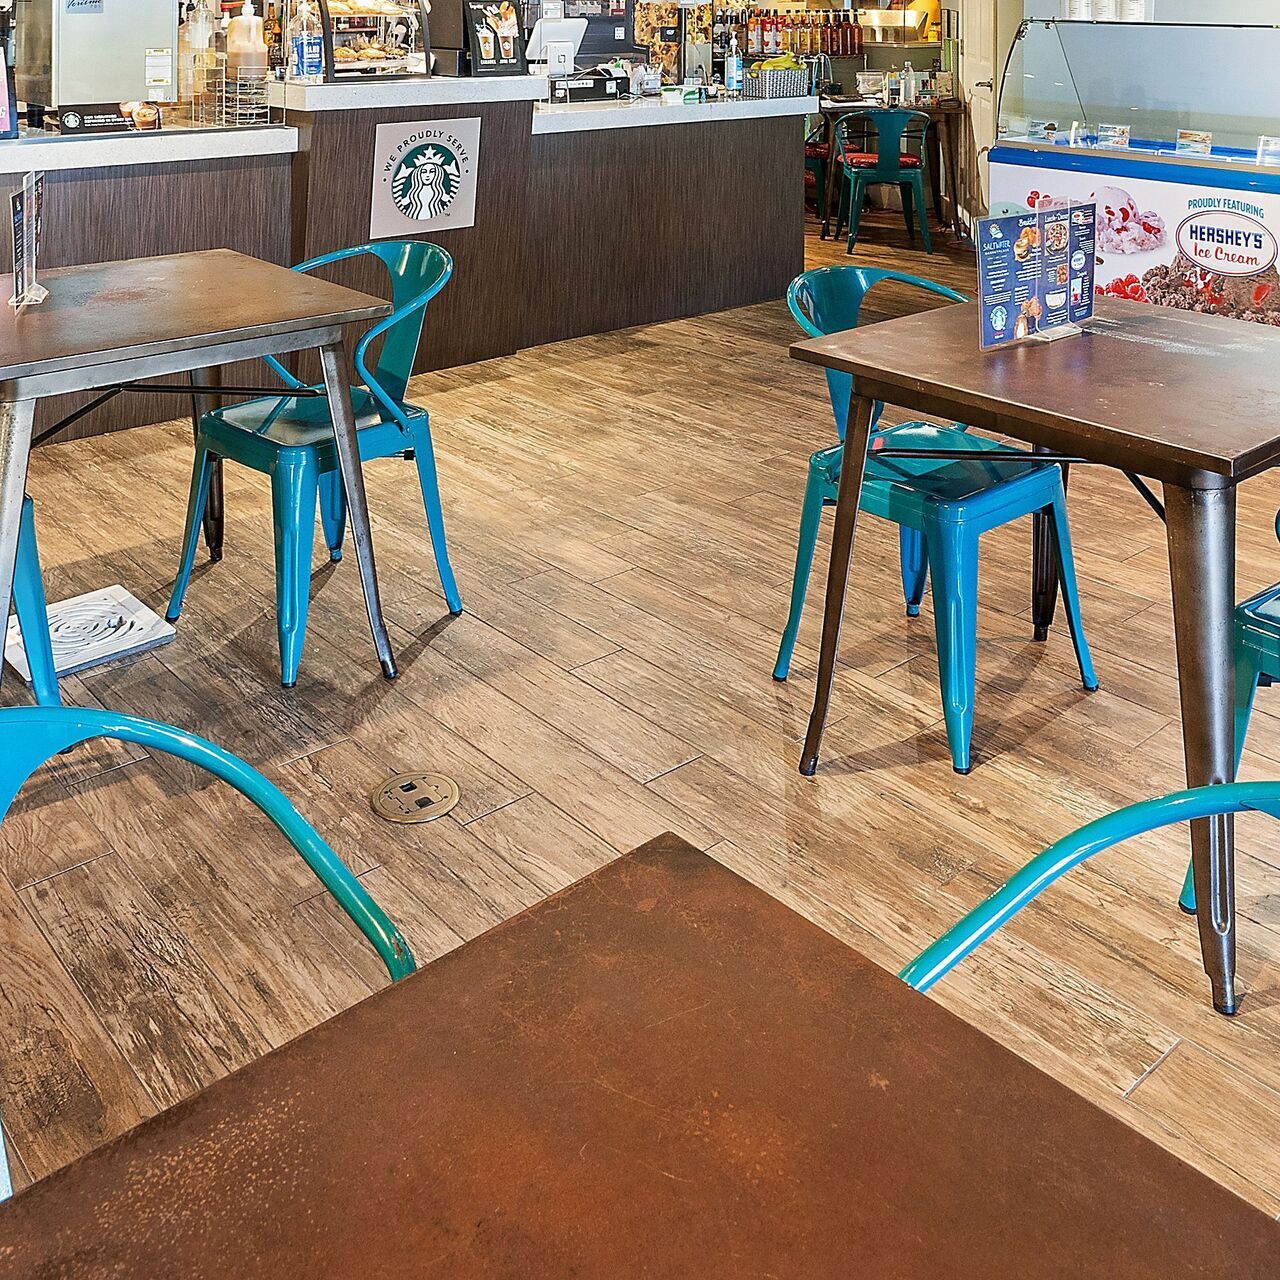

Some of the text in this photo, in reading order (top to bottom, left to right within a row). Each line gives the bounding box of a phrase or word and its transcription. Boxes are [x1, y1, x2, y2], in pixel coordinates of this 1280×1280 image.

[384, 130, 469, 172] WE PROUDLY SERVE
[1188, 198, 1264, 219] PROUDLY FEATURING
[1189, 224, 1264, 249] HERSHEY'S
[1194, 242, 1260, 266] Ice Cream
